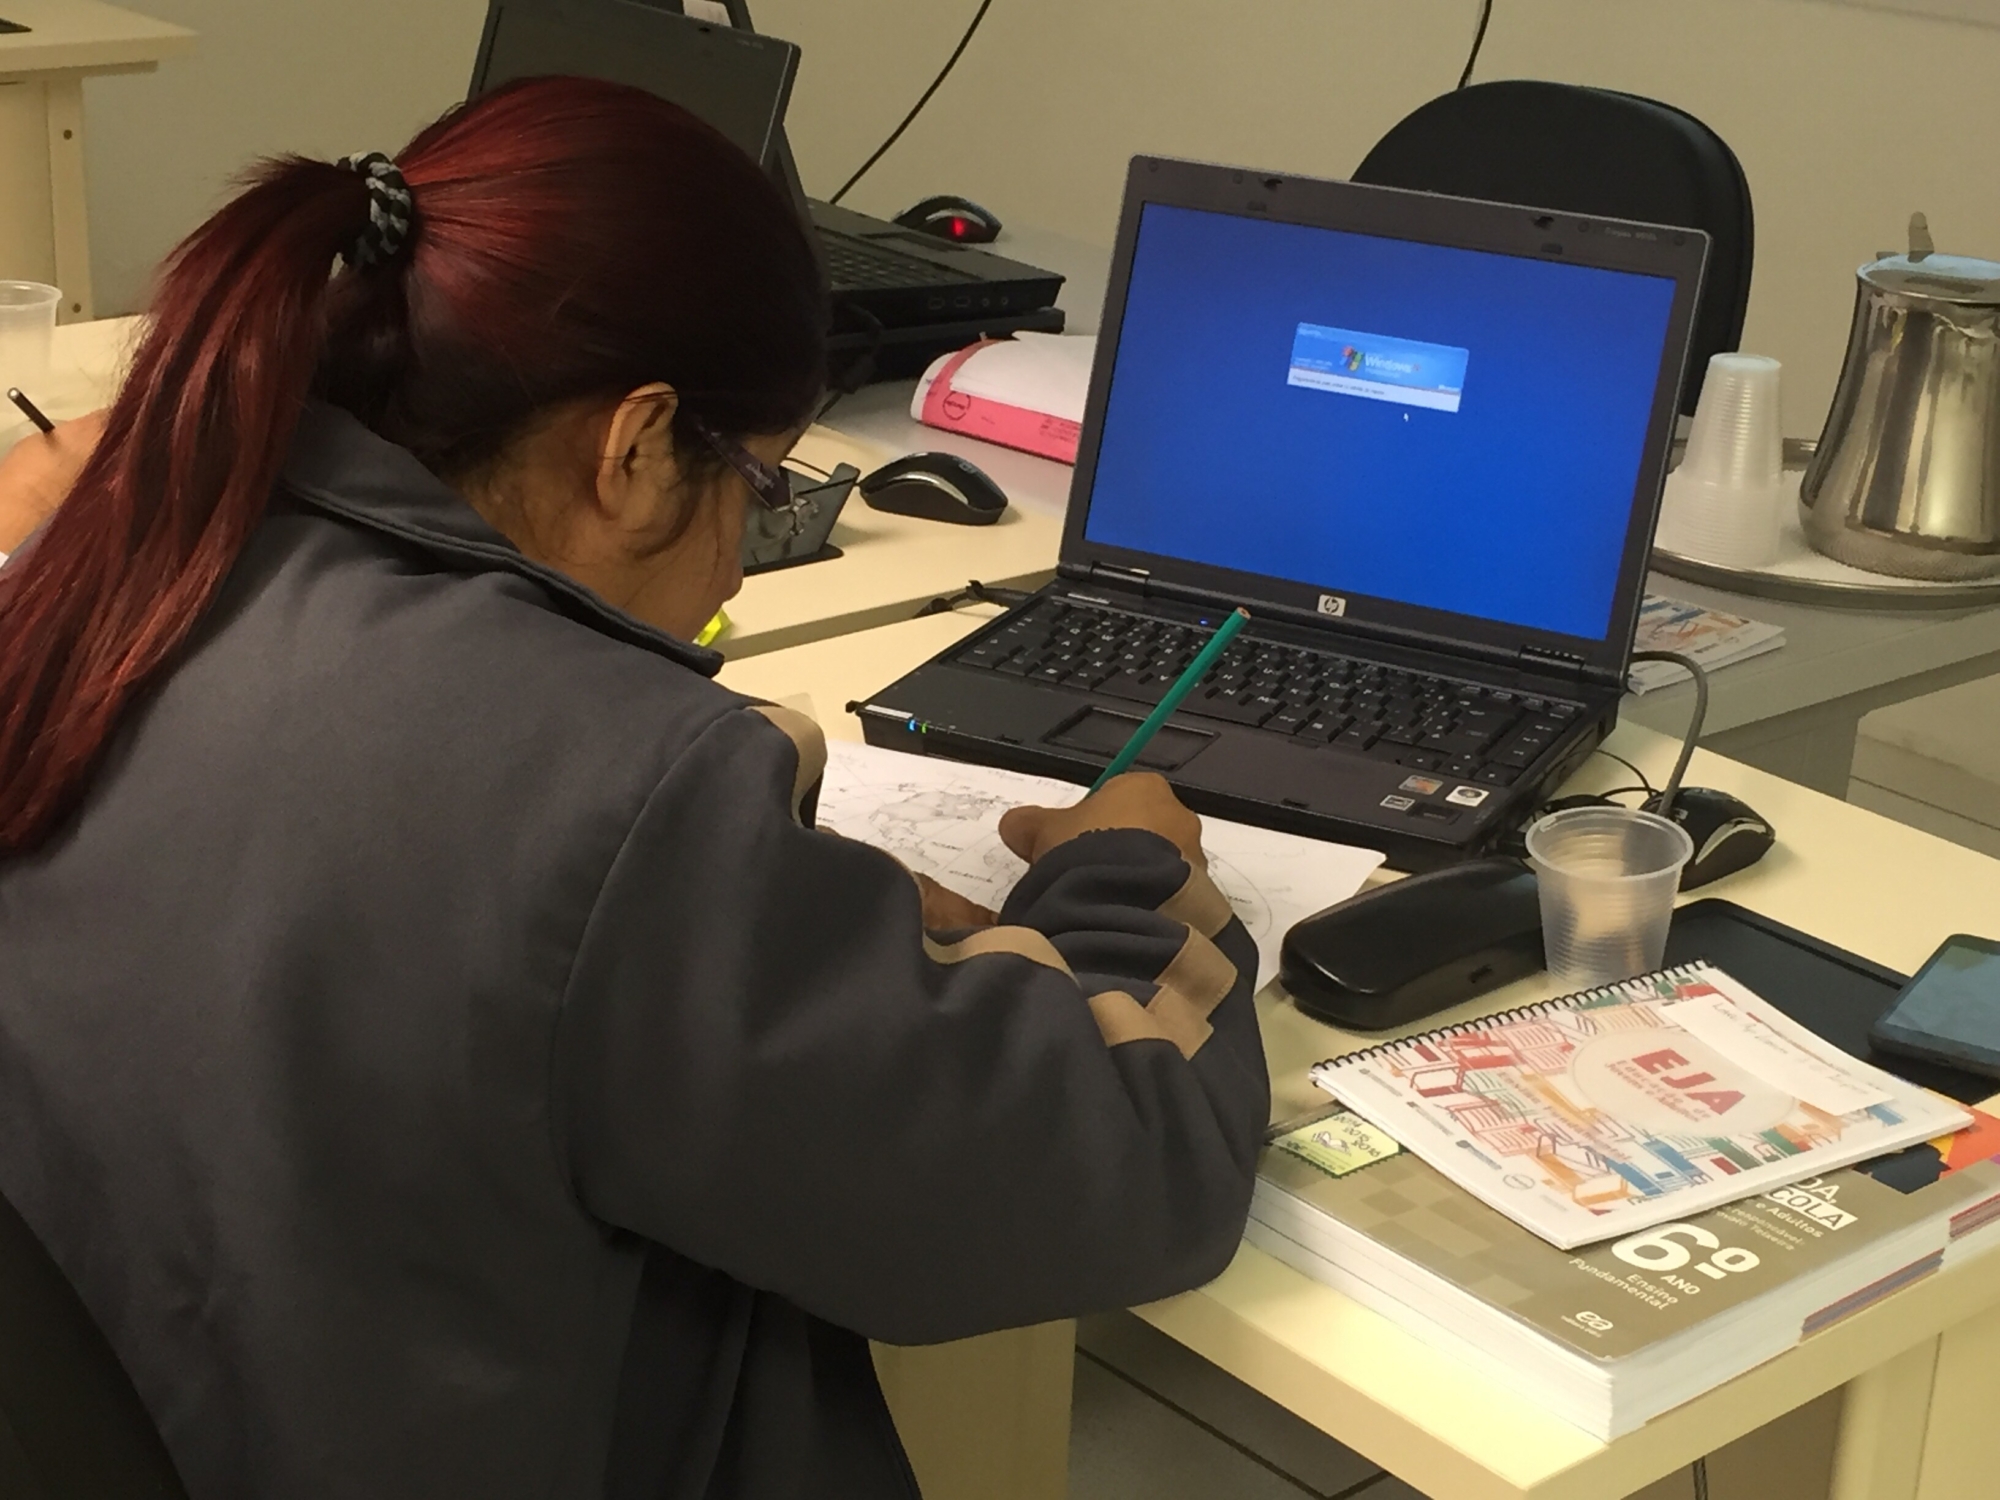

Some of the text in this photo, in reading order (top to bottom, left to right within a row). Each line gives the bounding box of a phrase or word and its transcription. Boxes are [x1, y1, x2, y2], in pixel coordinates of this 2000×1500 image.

[1631, 1048, 1746, 1115] EJA
[1766, 1207, 1824, 1238] Adultos
[1611, 1223, 1761, 1280] 6º
[1569, 1258, 1670, 1310] Fundamental
[1626, 1273, 1679, 1304] Ensino
[1660, 1274, 1701, 1295] ANO
